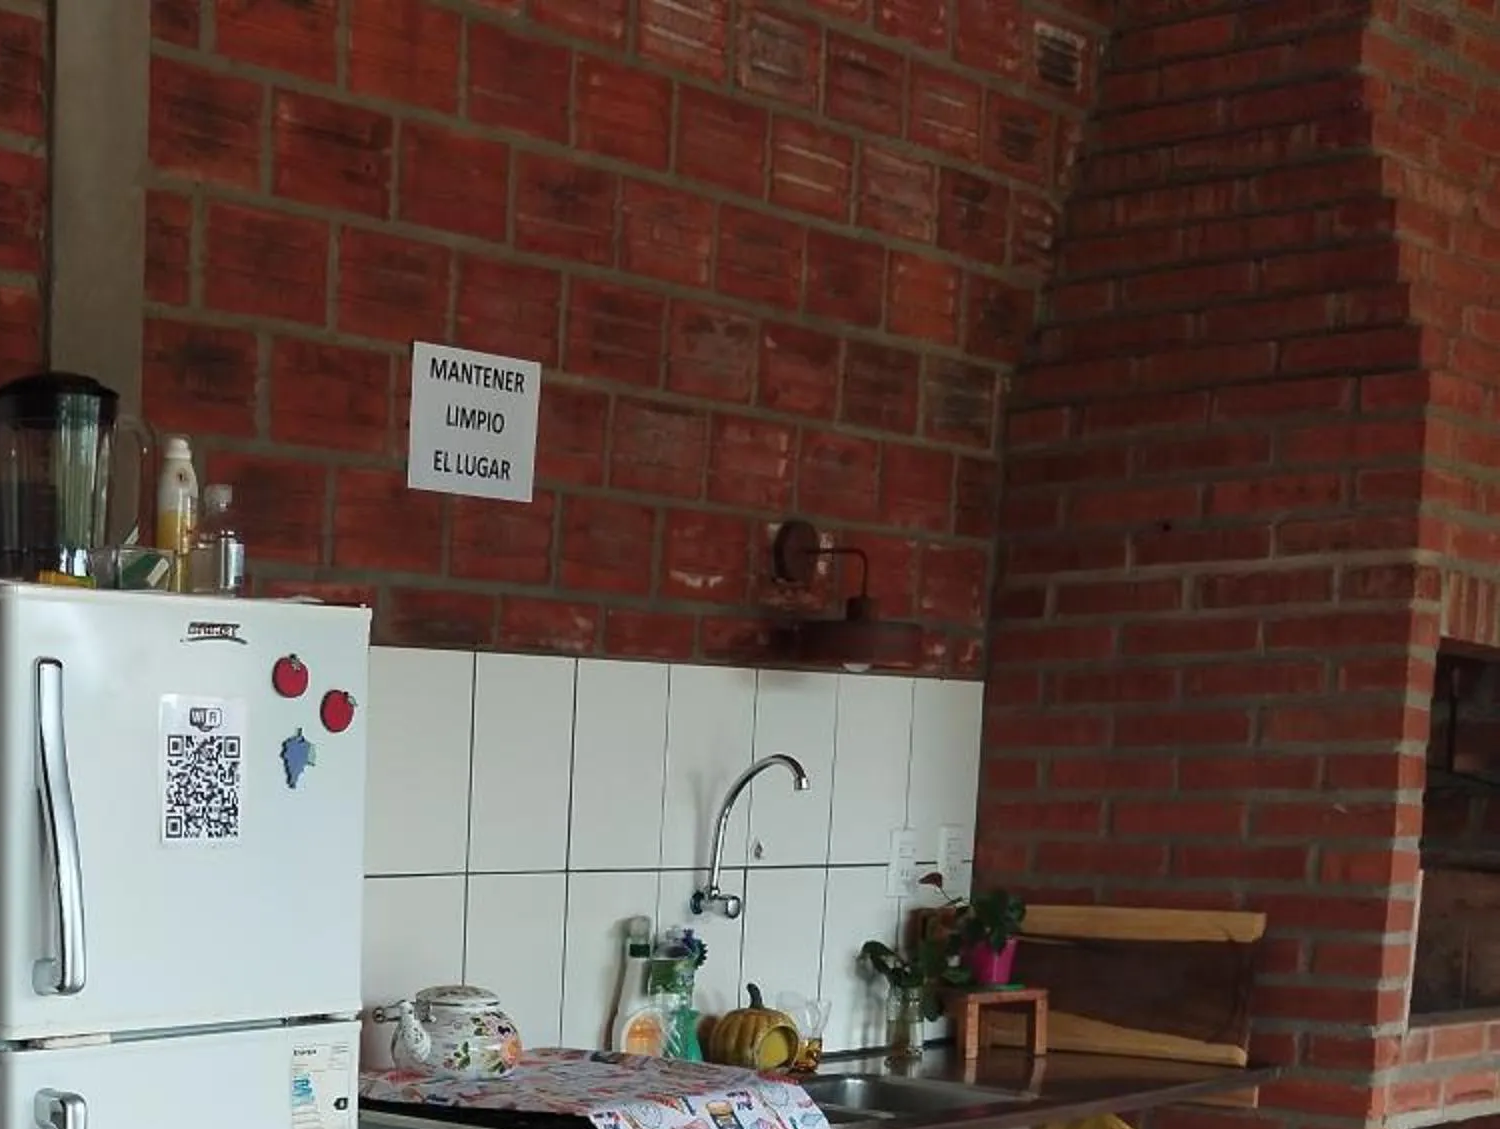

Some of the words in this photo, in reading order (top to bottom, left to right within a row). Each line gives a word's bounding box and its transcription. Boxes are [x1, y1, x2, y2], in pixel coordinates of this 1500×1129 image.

[430, 357, 525, 394] MANTENER
[446, 404, 505, 434] LIMPIO
[433, 450, 451, 473] EL
[456, 452, 511, 481] LUGAR
